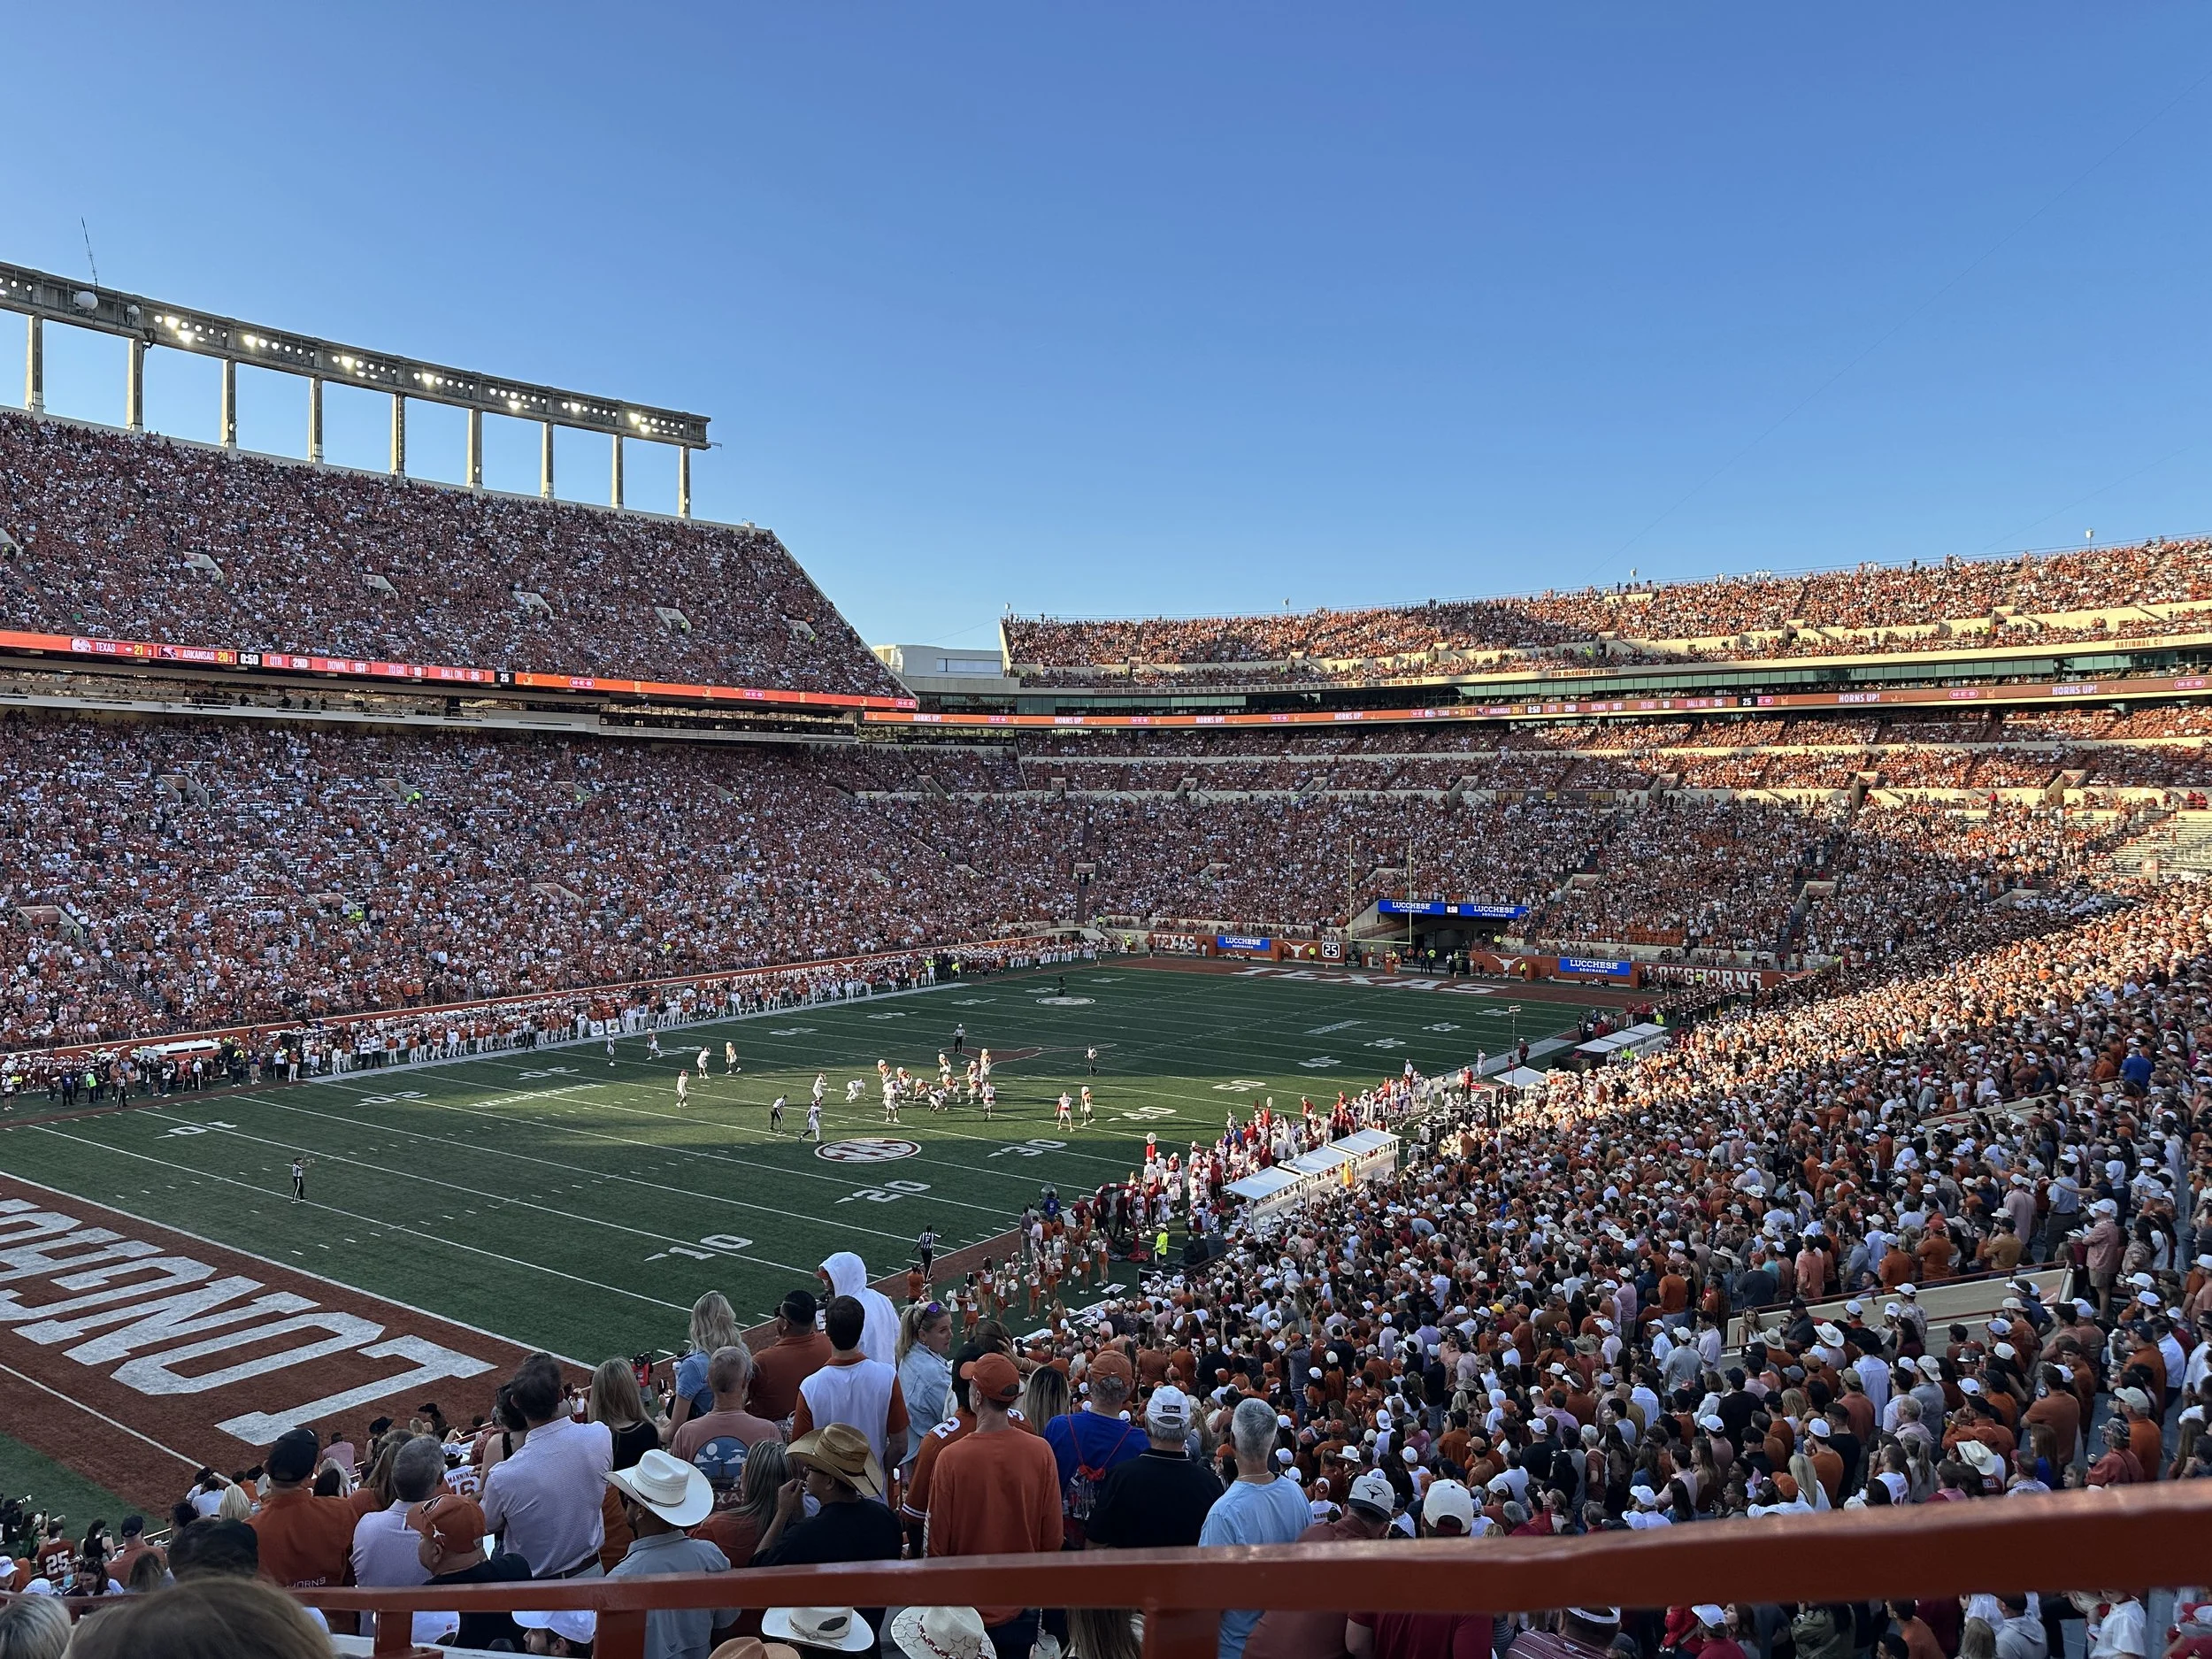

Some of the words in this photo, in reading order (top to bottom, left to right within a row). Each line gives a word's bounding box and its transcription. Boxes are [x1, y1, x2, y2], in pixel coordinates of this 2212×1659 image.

[96, 641, 116, 653] TEXAS
[134, 645, 143, 656] 21
[2115, 640, 2150, 649] NATIONAL
[182, 650, 215, 661] ARKANSAS
[217, 652, 229, 663] 20
[240, 654, 259, 665] 0:50
[269, 656, 282, 666] QTR
[292, 657, 308, 668] 2ND
[326, 660, 346, 671] DOWN
[354, 663, 367, 672] 1ST
[388, 664, 396, 674] TO
[396, 665, 404, 675] GO
[413, 666, 422, 677] 10
[441, 668, 455, 679] BALL
[455, 670, 463, 680] ON
[470, 672, 480, 680] 35
[500, 673, 510, 683] 25
[2052, 685, 2081, 695] HORNS
[2082, 684, 2097, 694] UP!
[1838, 694, 1865, 703] HORNS
[1866, 693, 1879, 702] UP!
[913, 713, 933, 723] HORNS
[1054, 716, 1073, 725] HORNS
[1334, 711, 1353, 721] HORNS
[1473, 905, 1516, 914] LUCCHESE
[1153, 933, 1197, 950] TEXAS
[1225, 937, 1262, 946] LUCCHESE
[1325, 945, 1339, 956] 25
[1569, 960, 1619, 970] LUCCHESE
[1231, 966, 1511, 995] TEXAS
[360, 1090, 429, 1104] 20
[1121, 1106, 1178, 1120] 40
[167, 1120, 238, 1136] 10
[1000, 1139, 1068, 1157] 30
[851, 1179, 932, 1203] 20
[667, 1233, 754, 1260] 10
[0, 1198, 498, 1447] LONGH
[45, 1549, 69, 1576] 25
